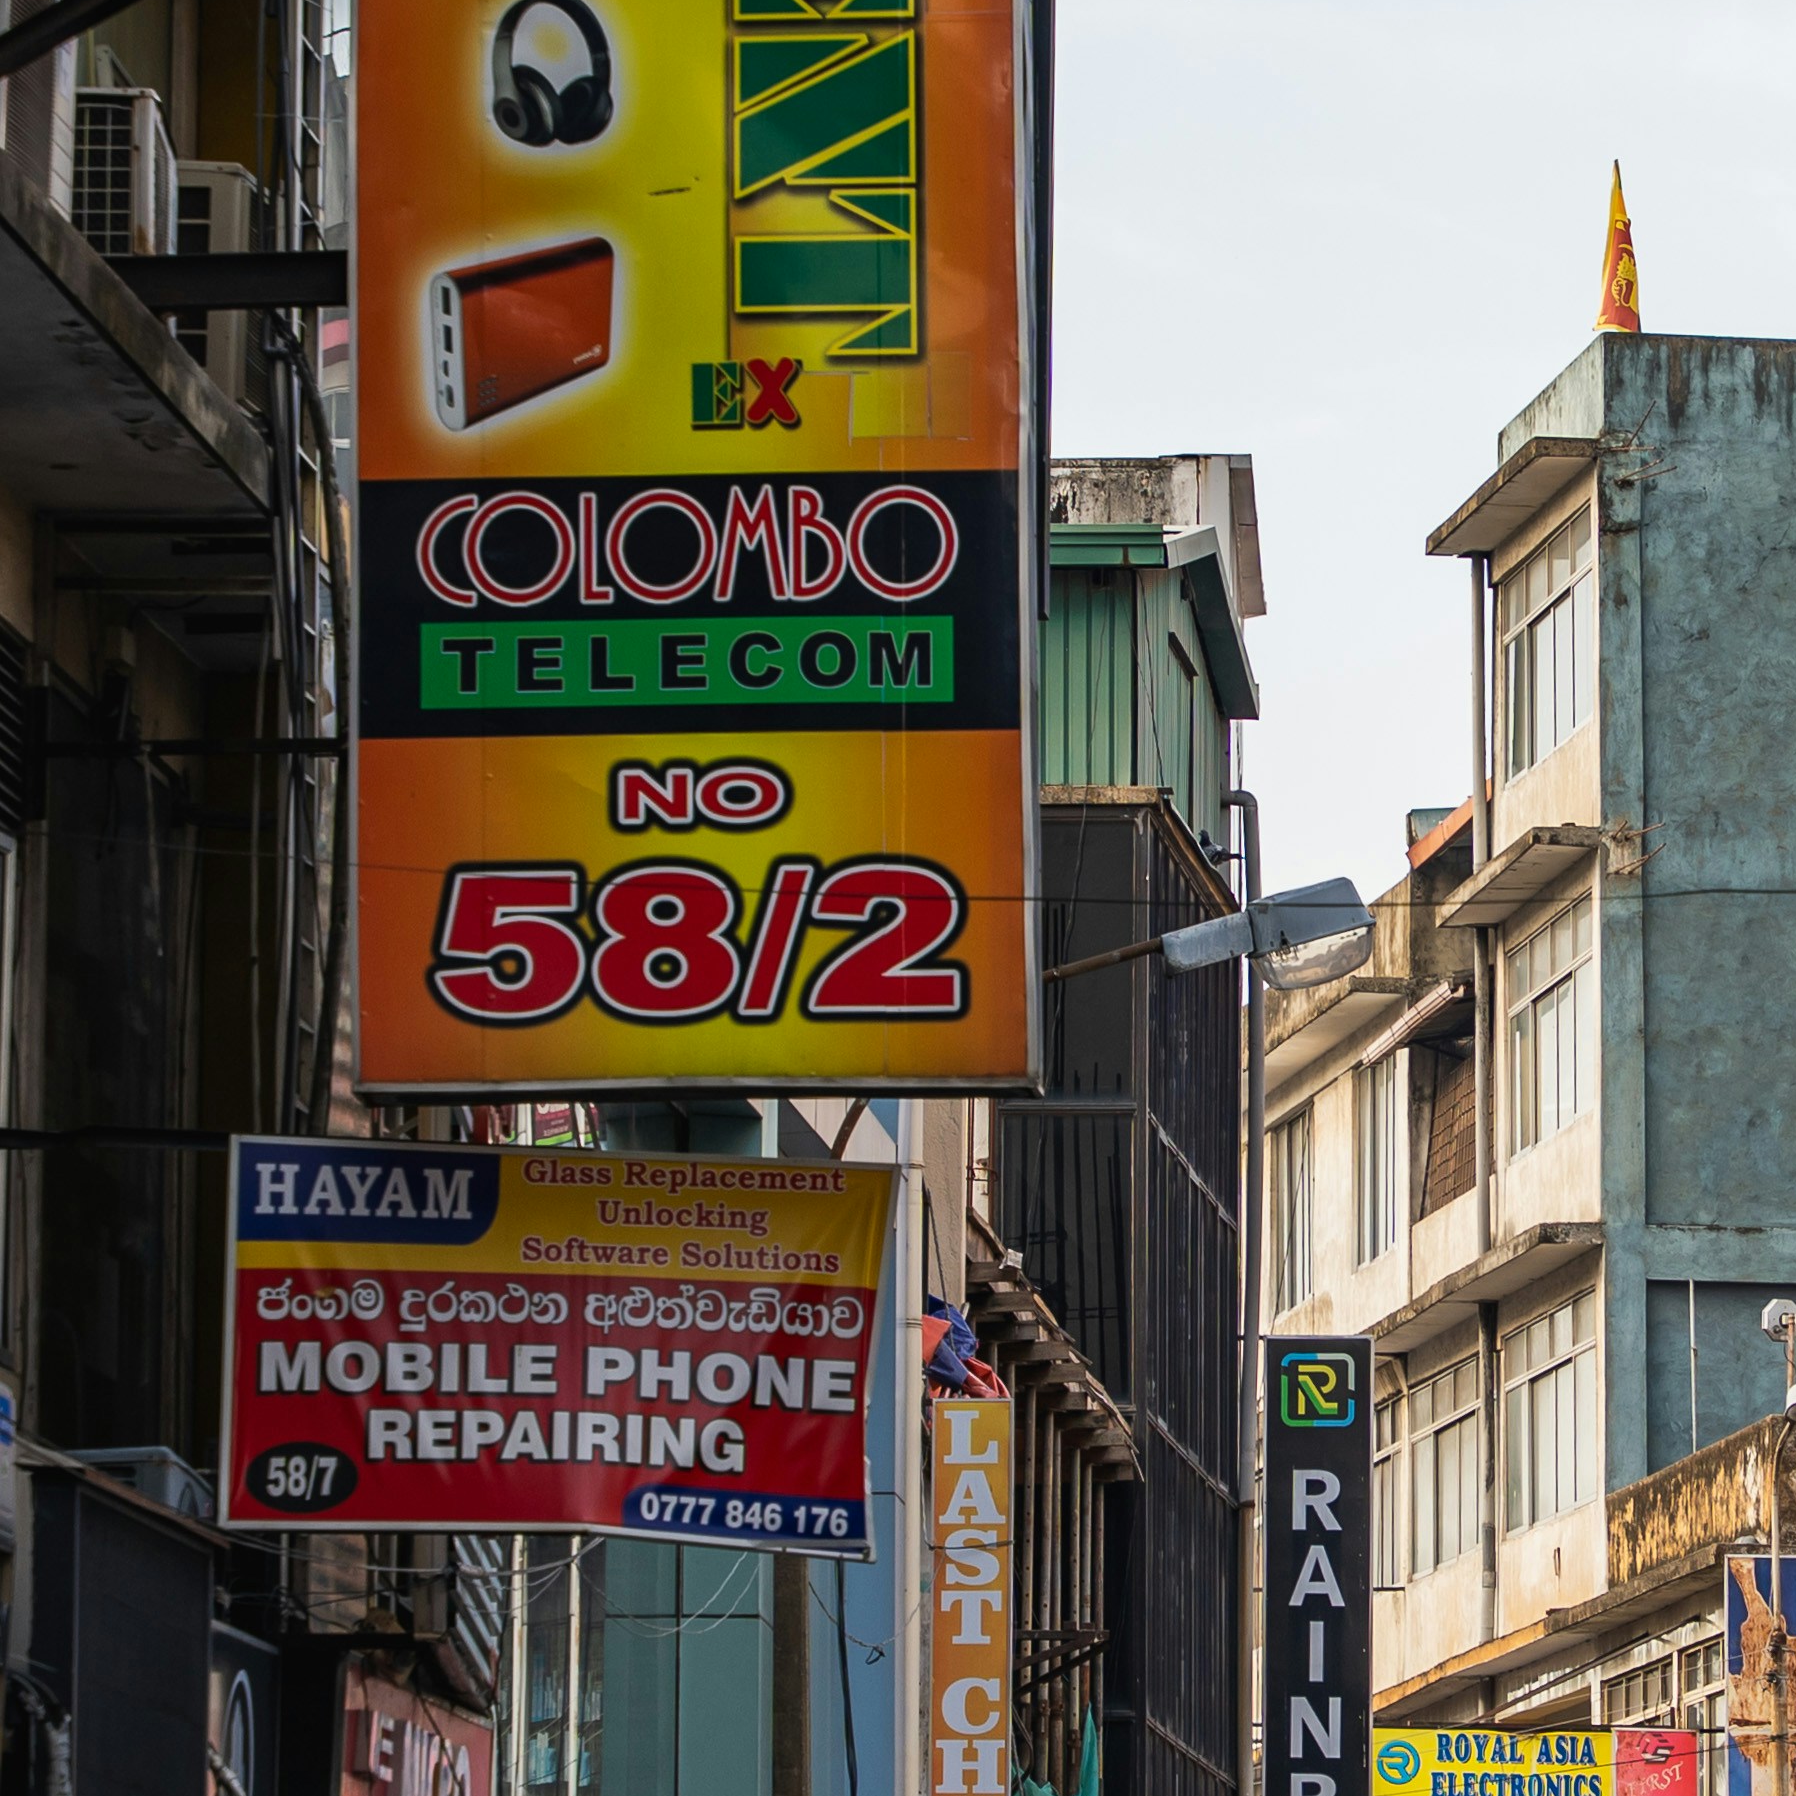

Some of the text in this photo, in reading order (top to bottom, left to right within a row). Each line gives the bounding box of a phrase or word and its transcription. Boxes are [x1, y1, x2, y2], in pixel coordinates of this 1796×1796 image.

[691, 357, 801, 427] EX
[416, 484, 959, 607] COLOMBO
[441, 630, 932, 693] TELECOM
[614, 762, 788, 828] NO
[430, 860, 964, 1022] 58/2
[255, 1162, 473, 1221] HAYAM
[523, 1157, 845, 1195] Glass Replacement
[598, 1199, 769, 1237] Unlocking
[522, 1237, 840, 1275] Software Solutions
[257, 1278, 384, 1322] ජංගම
[400, 1283, 568, 1332] දුරකථන
[258, 1340, 857, 1412] MOBILE PHONE
[367, 1409, 746, 1474] REPAIRING
[266, 1454, 337, 1500] 58/7
[639, 1493, 849, 1538] 0777 846 176
[938, 1410, 1006, 1646] LAST
[1436, 1732, 1596, 1766] ROYAL ASIA
